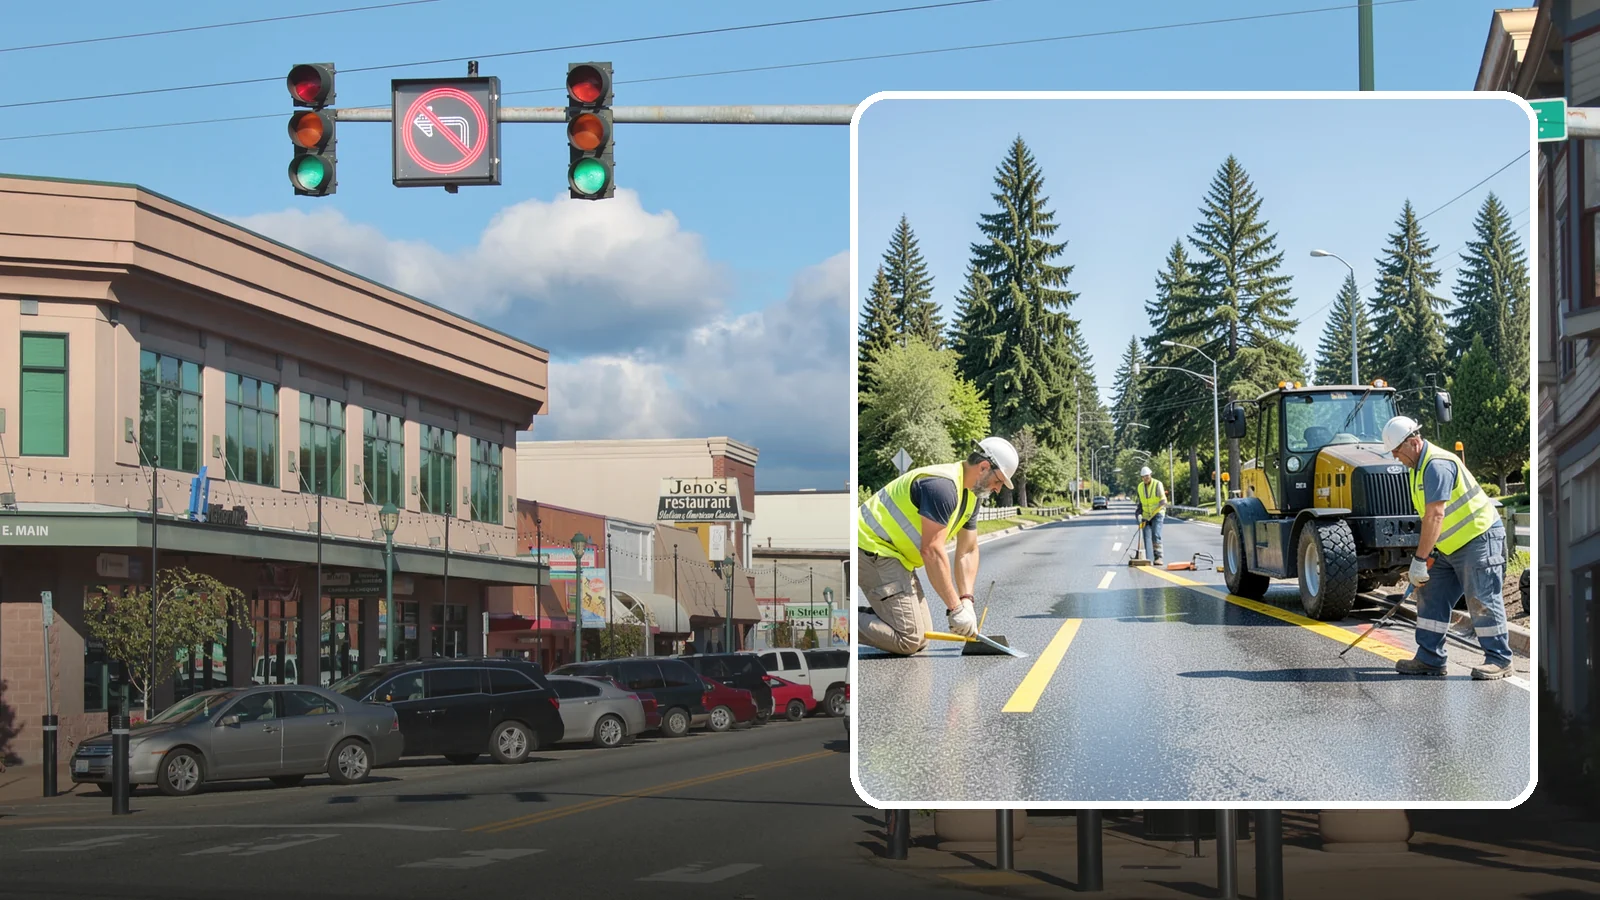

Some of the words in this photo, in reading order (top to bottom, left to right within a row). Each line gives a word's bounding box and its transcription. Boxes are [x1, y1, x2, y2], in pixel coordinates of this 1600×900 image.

[669, 480, 727, 494] Jeno's
[665, 496, 731, 509] restaurant
[659, 510, 681, 519] Italian
[686, 510, 714, 519] American
[715, 509, 737, 519] Cuisine
[2, 525, 13, 536] E.
[15, 525, 49, 536] MAIN
[797, 607, 829, 617] Street
[791, 619, 824, 627] lass
